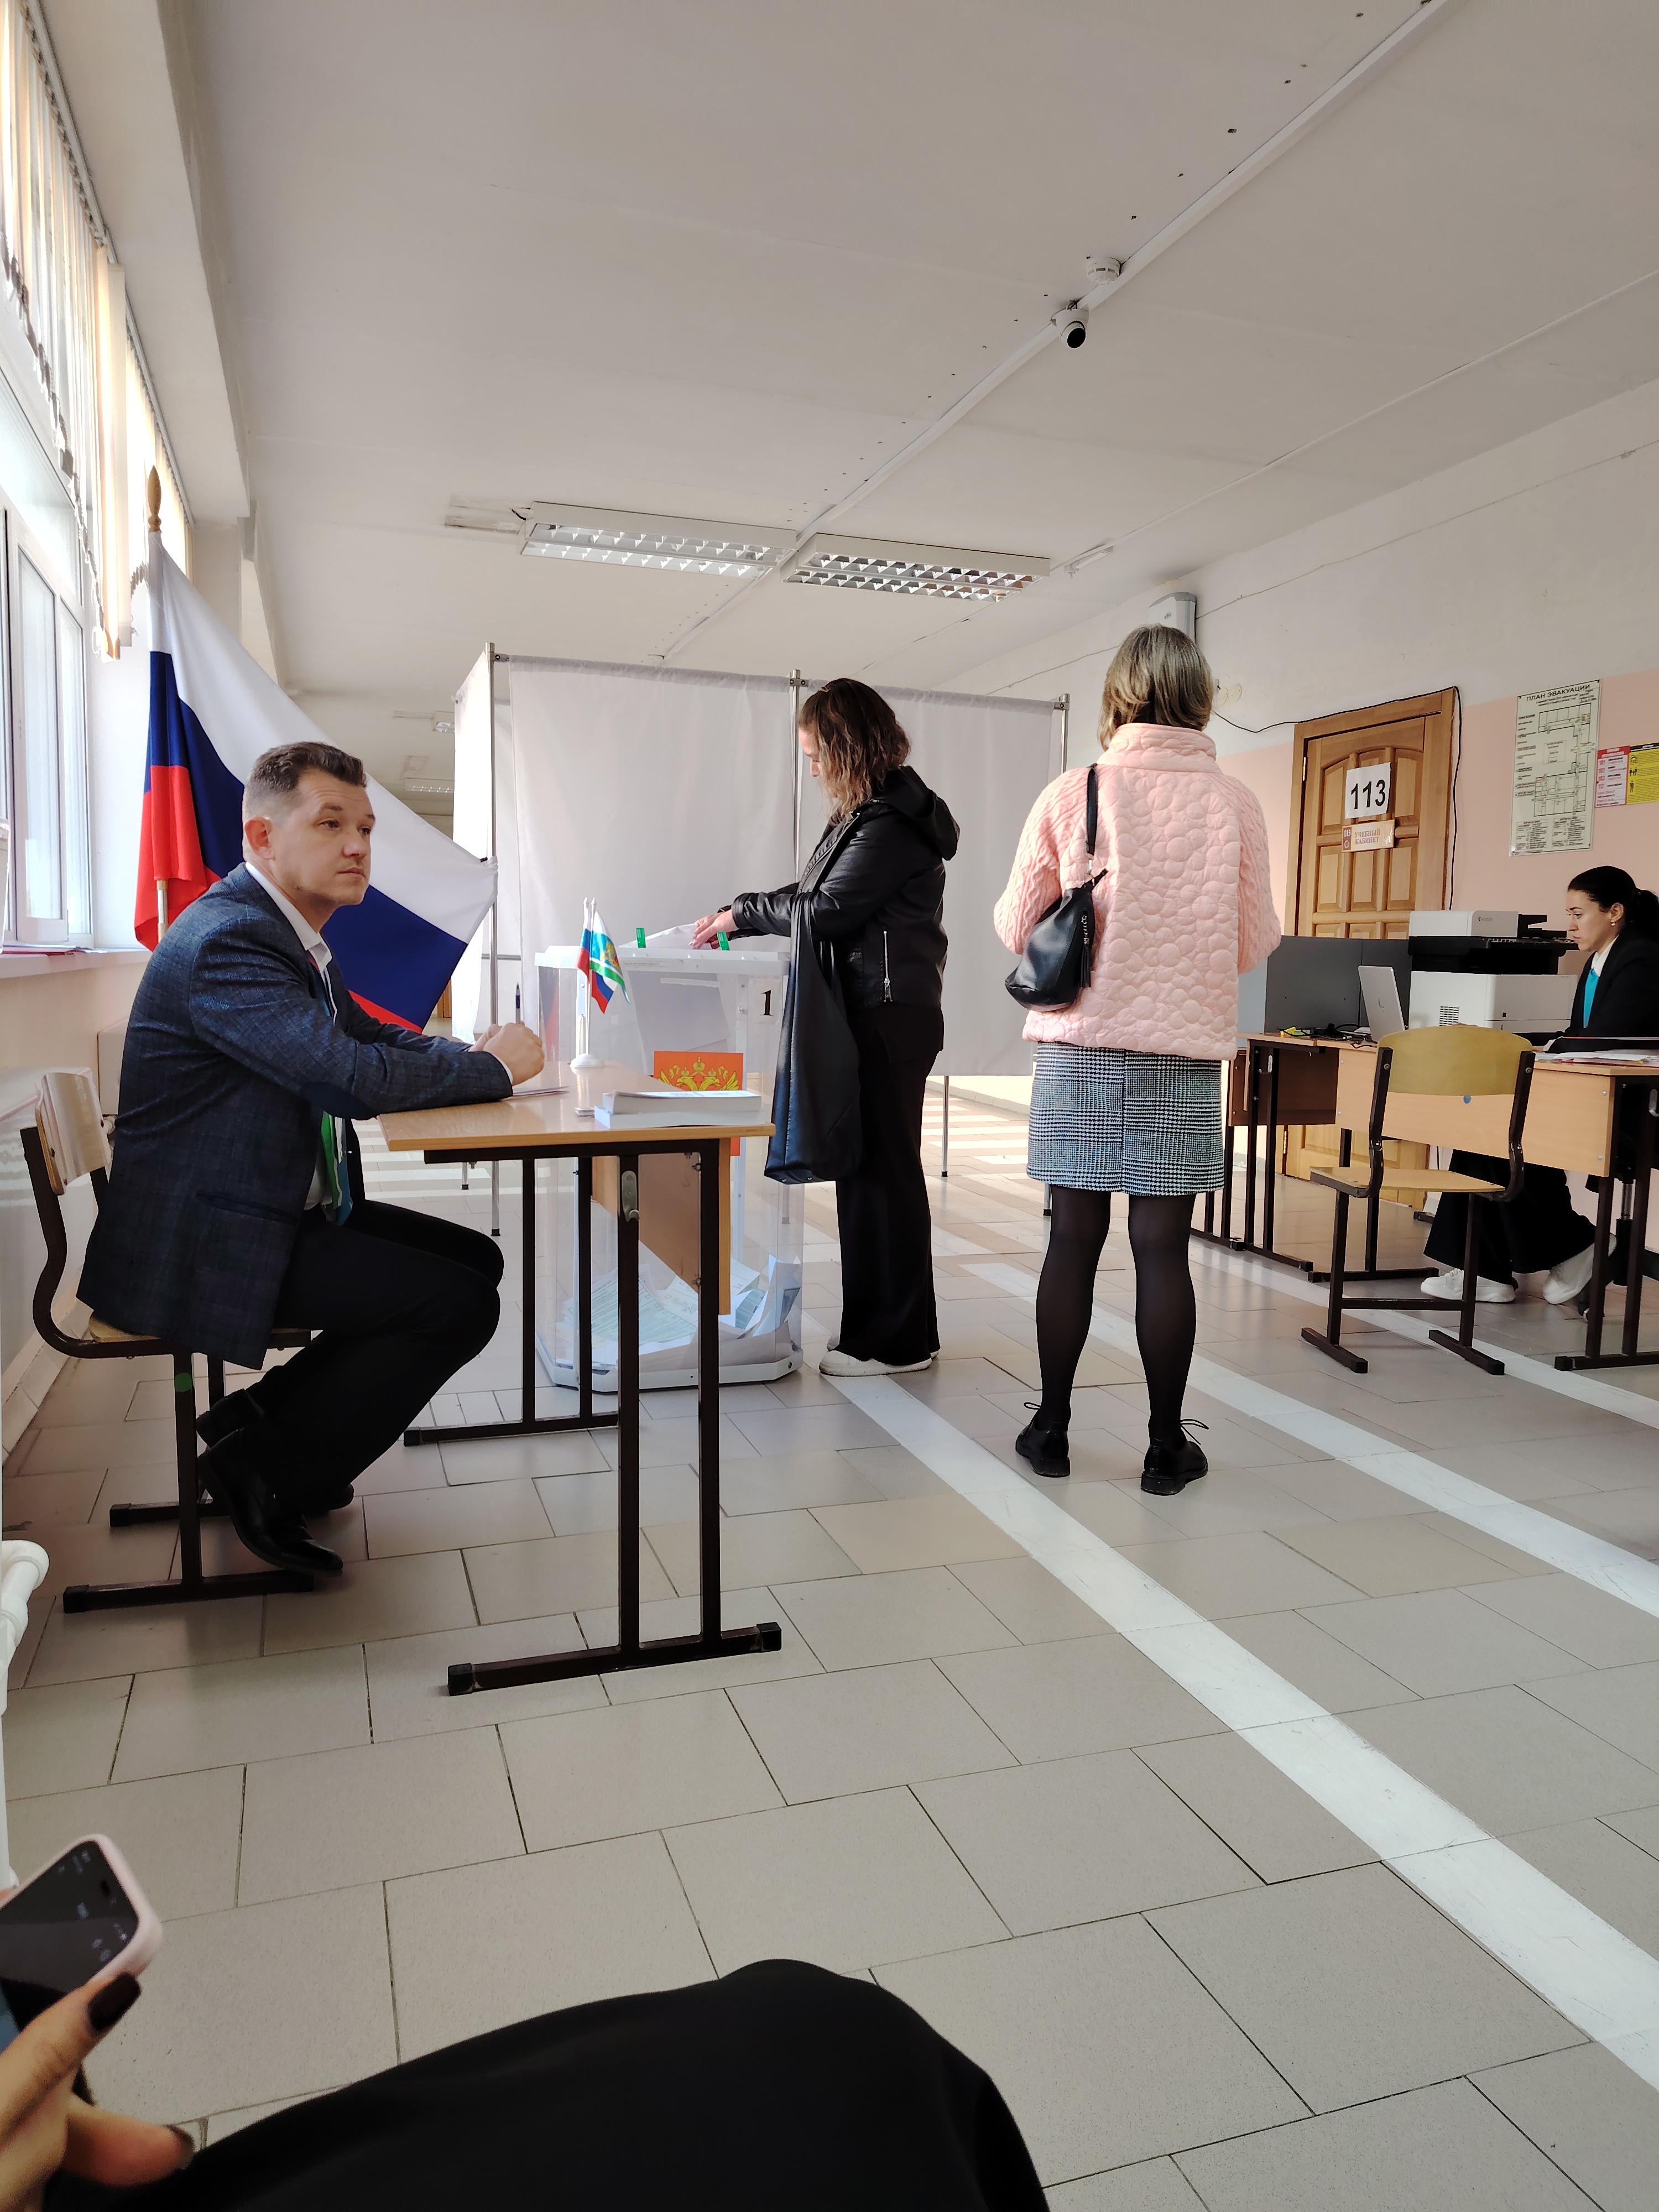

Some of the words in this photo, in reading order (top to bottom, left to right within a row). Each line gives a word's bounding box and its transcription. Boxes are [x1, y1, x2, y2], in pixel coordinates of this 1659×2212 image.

[1526, 693, 1546, 702] ПЛАН
[1547, 684, 1590, 697] ЭВАКУАЦИИ
[1351, 779, 1386, 810] 113
[1355, 828, 1380, 838] УЧЕБНЫЙ
[1355, 836, 1380, 845] КАБИНЕТ
[760, 989, 774, 1016] 1
